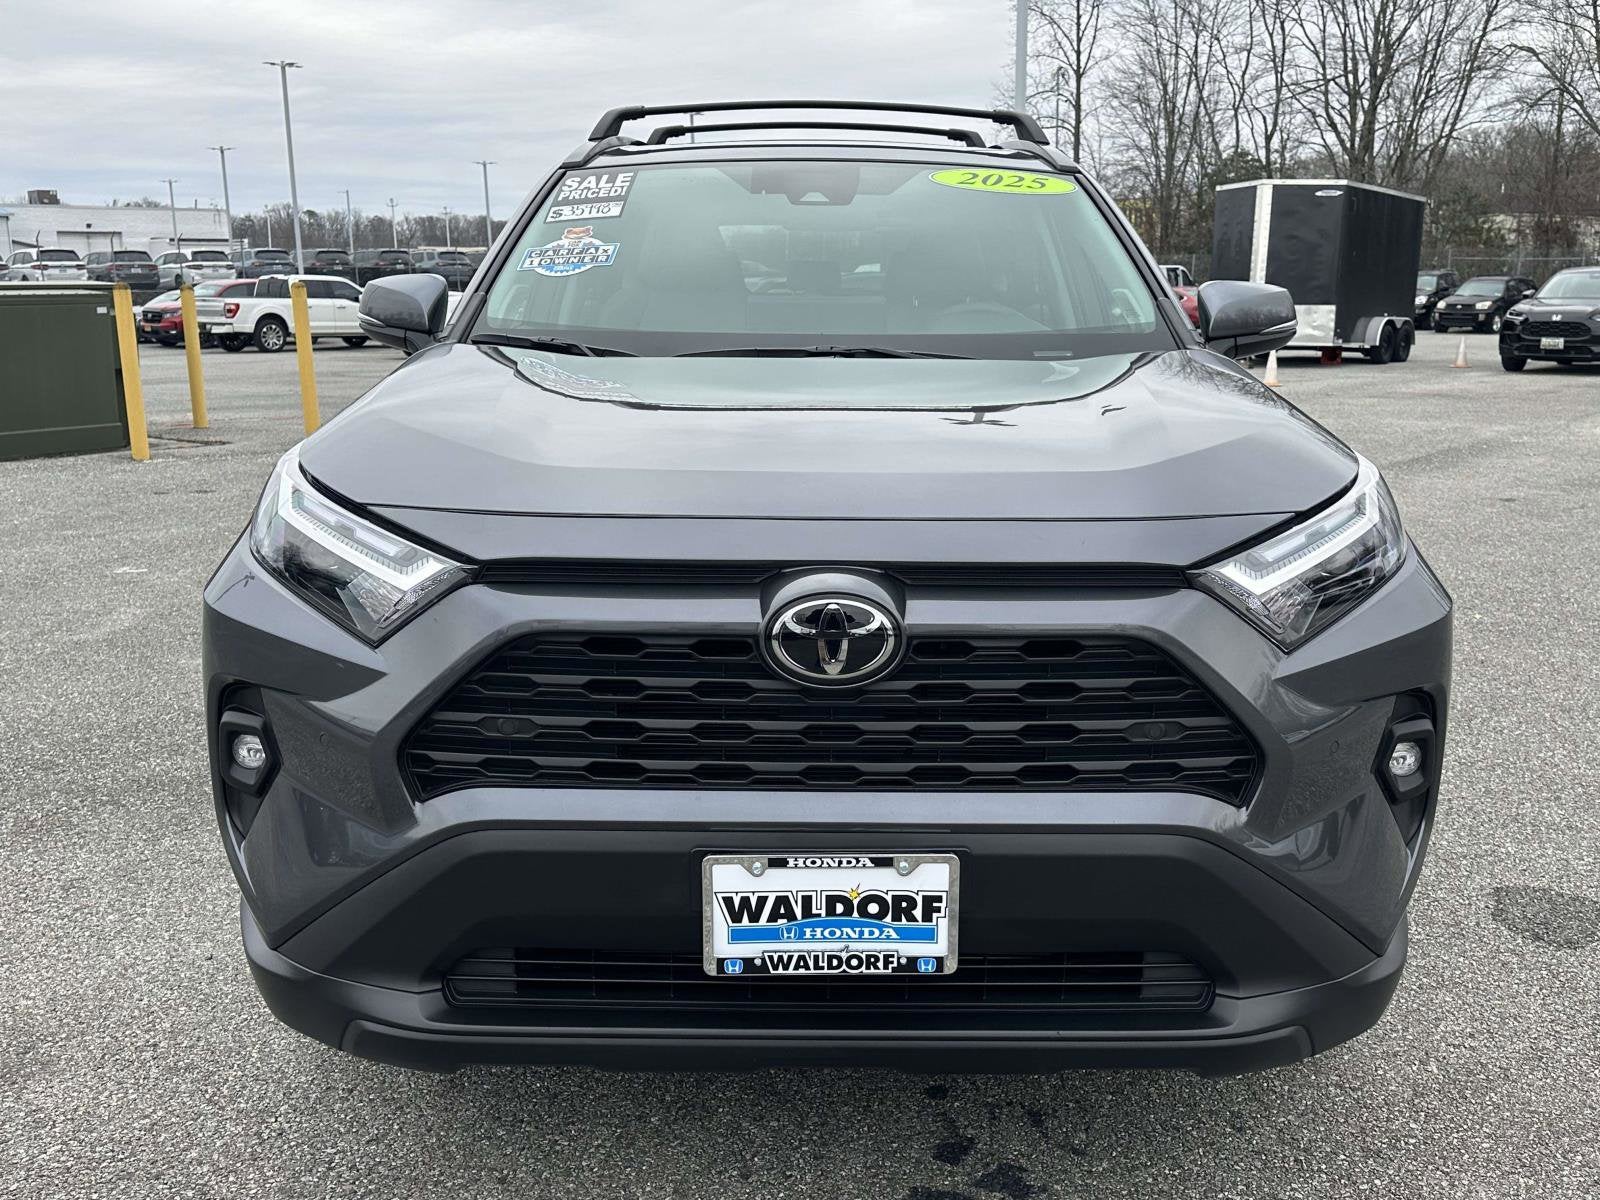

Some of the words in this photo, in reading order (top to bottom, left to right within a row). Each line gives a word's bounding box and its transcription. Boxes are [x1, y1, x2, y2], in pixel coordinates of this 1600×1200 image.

[561, 172, 634, 192] SALE
[957, 172, 1049, 190] 2025
[558, 186, 628, 201] PRICED!
[527, 247, 611, 259] CARFAX
[786, 857, 875, 868] HONDA
[720, 893, 945, 924] WALDORF
[803, 927, 900, 939] HONDA
[766, 952, 898, 973] WALDORF
